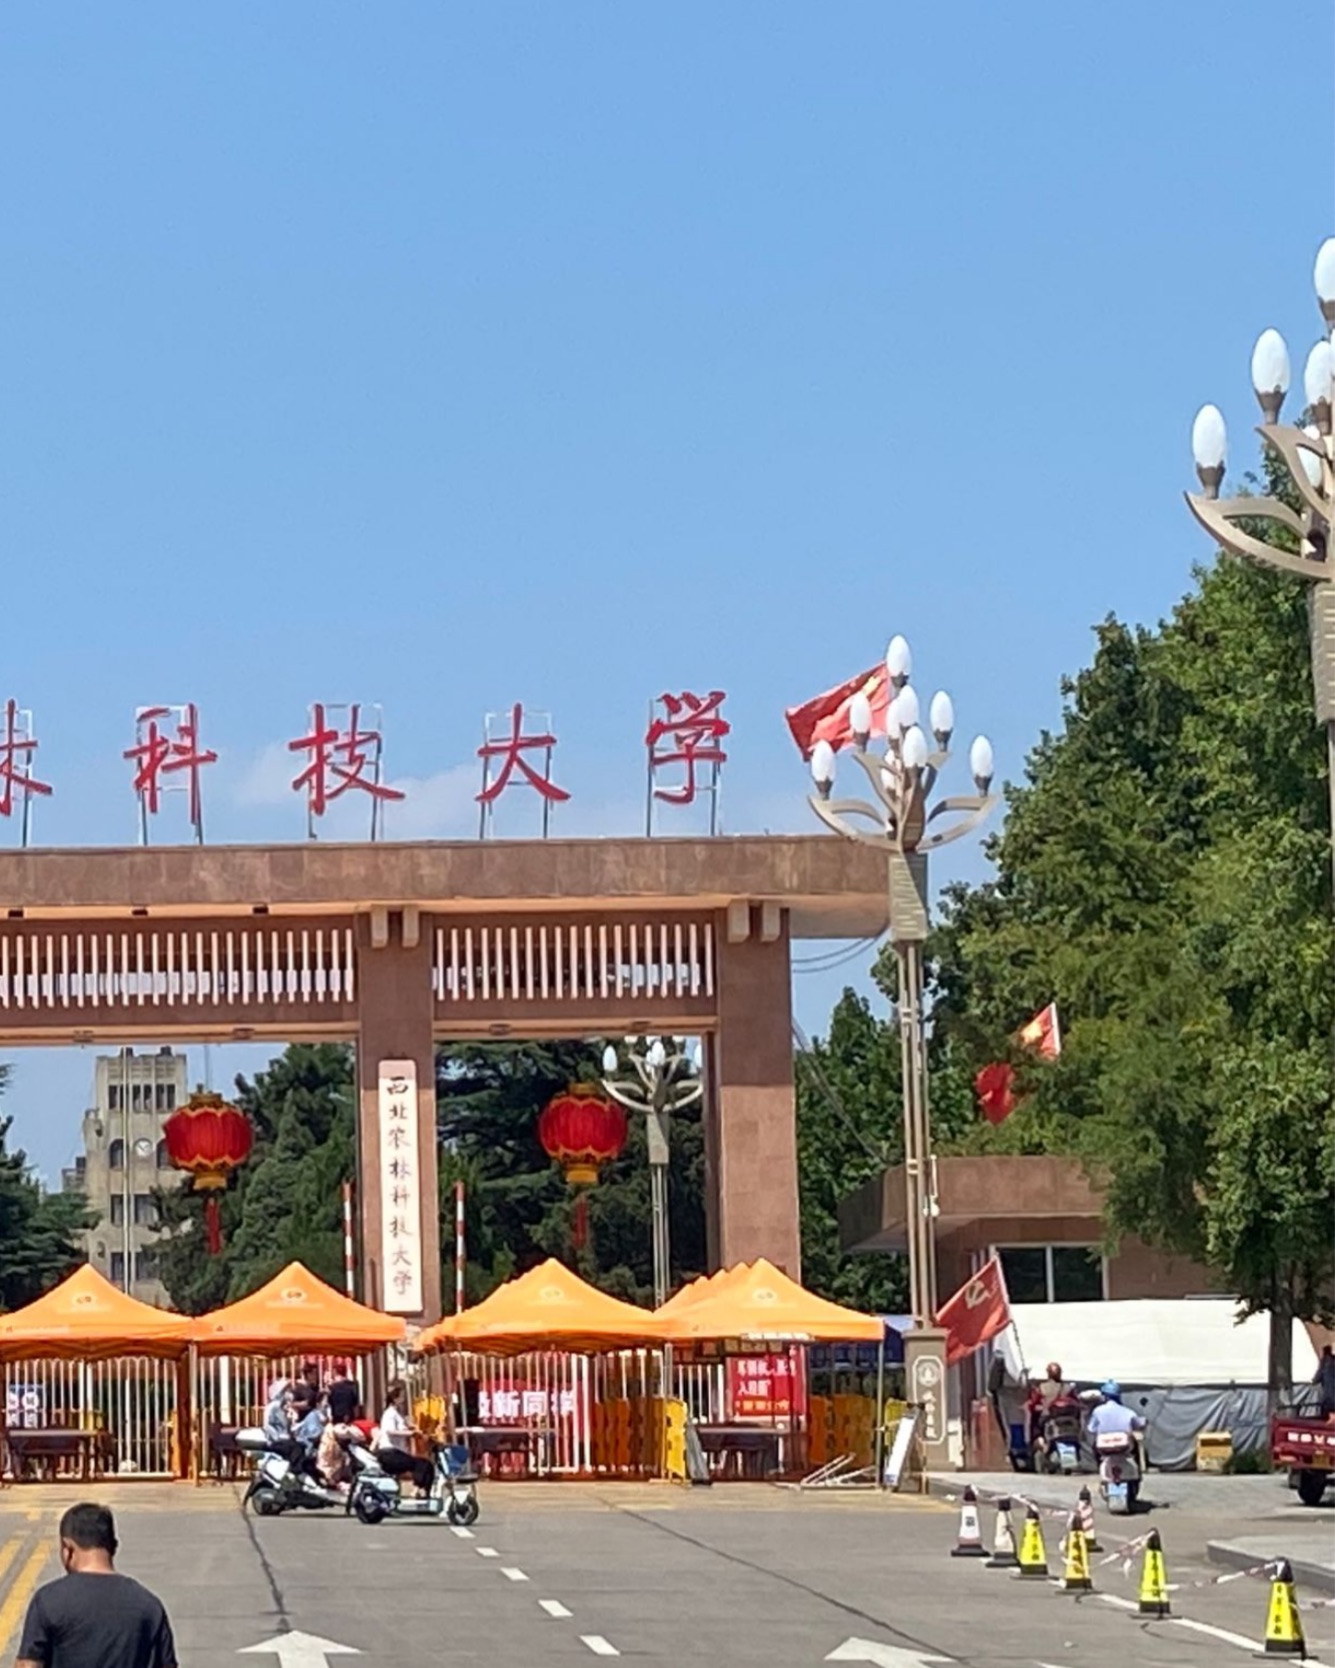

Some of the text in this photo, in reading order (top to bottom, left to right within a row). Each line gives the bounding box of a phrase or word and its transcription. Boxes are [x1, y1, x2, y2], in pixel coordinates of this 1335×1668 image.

[386, 1076, 413, 1296] 西北农林科技大学
